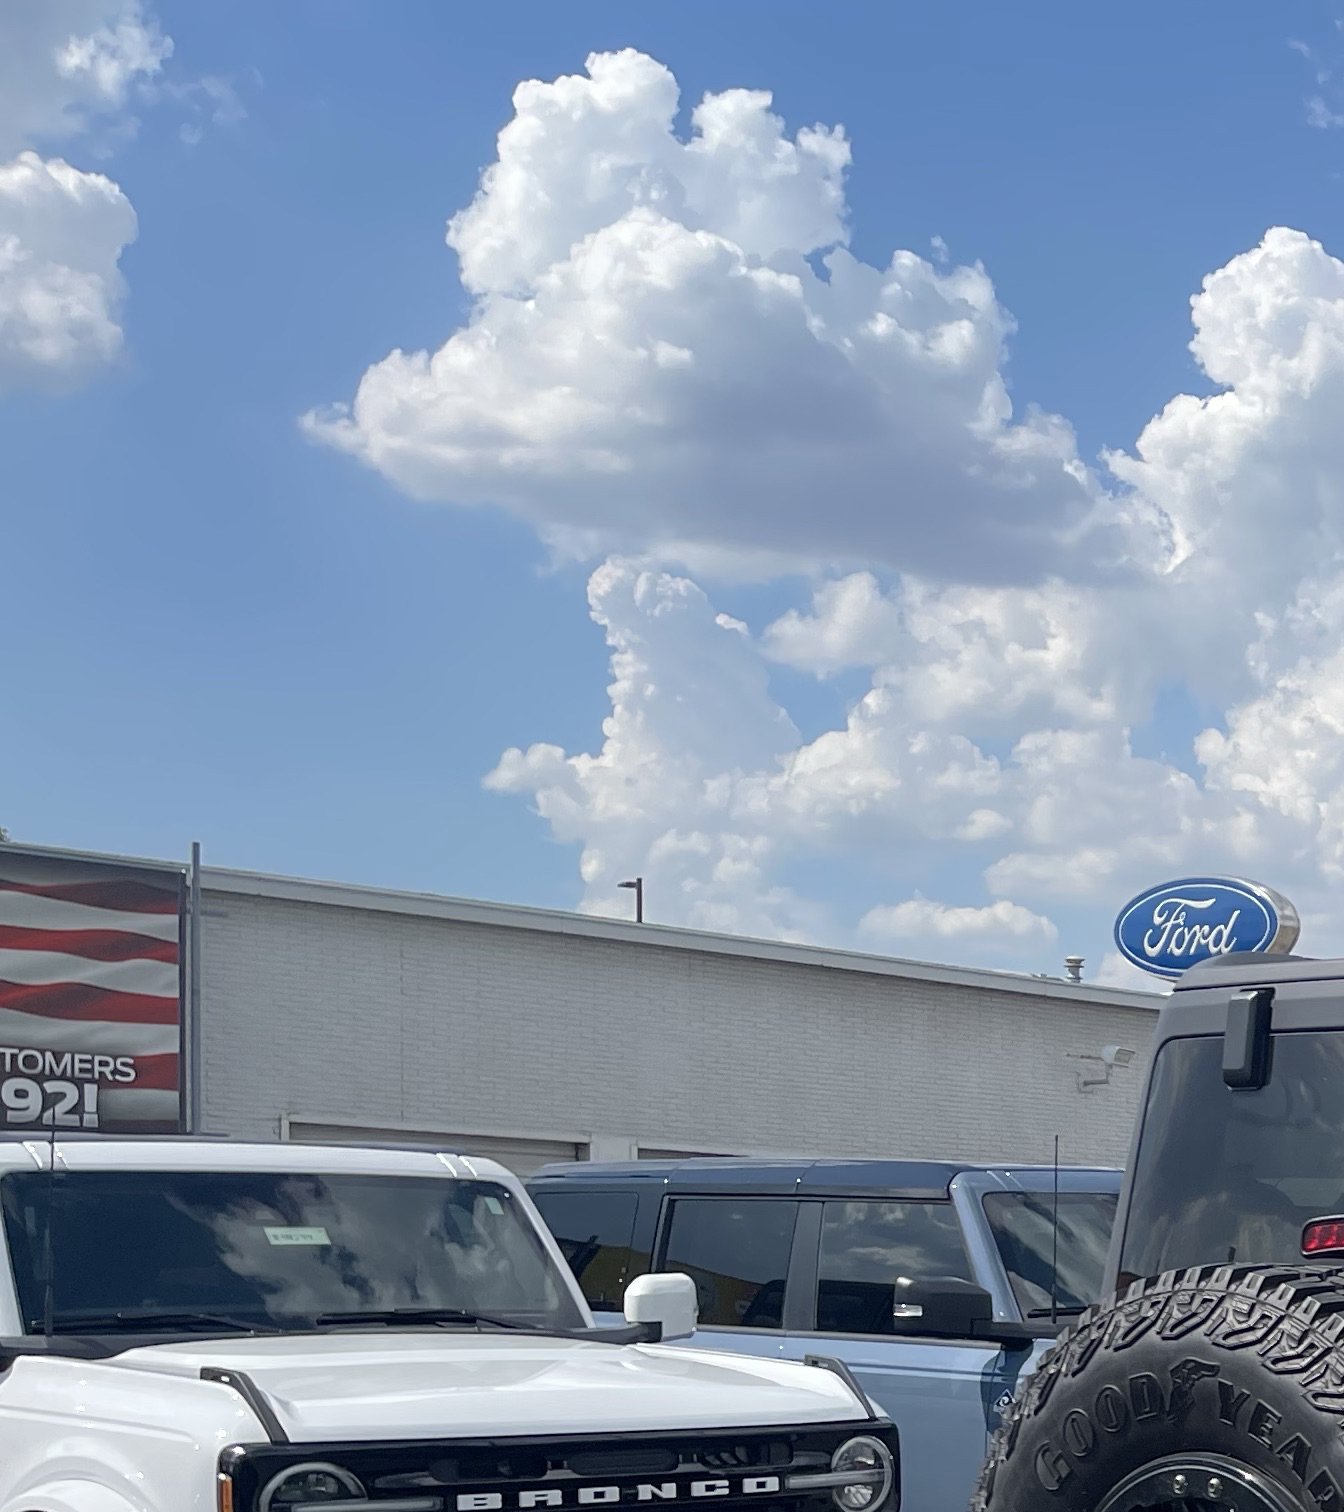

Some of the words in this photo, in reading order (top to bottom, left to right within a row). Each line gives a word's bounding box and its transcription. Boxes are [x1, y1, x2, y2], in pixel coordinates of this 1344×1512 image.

[1143, 898, 1241, 957] Ford
[0, 1048, 136, 1082] TOMERS
[1, 1077, 99, 1128] 92!
[456, 1476, 780, 1511] BRONCO
